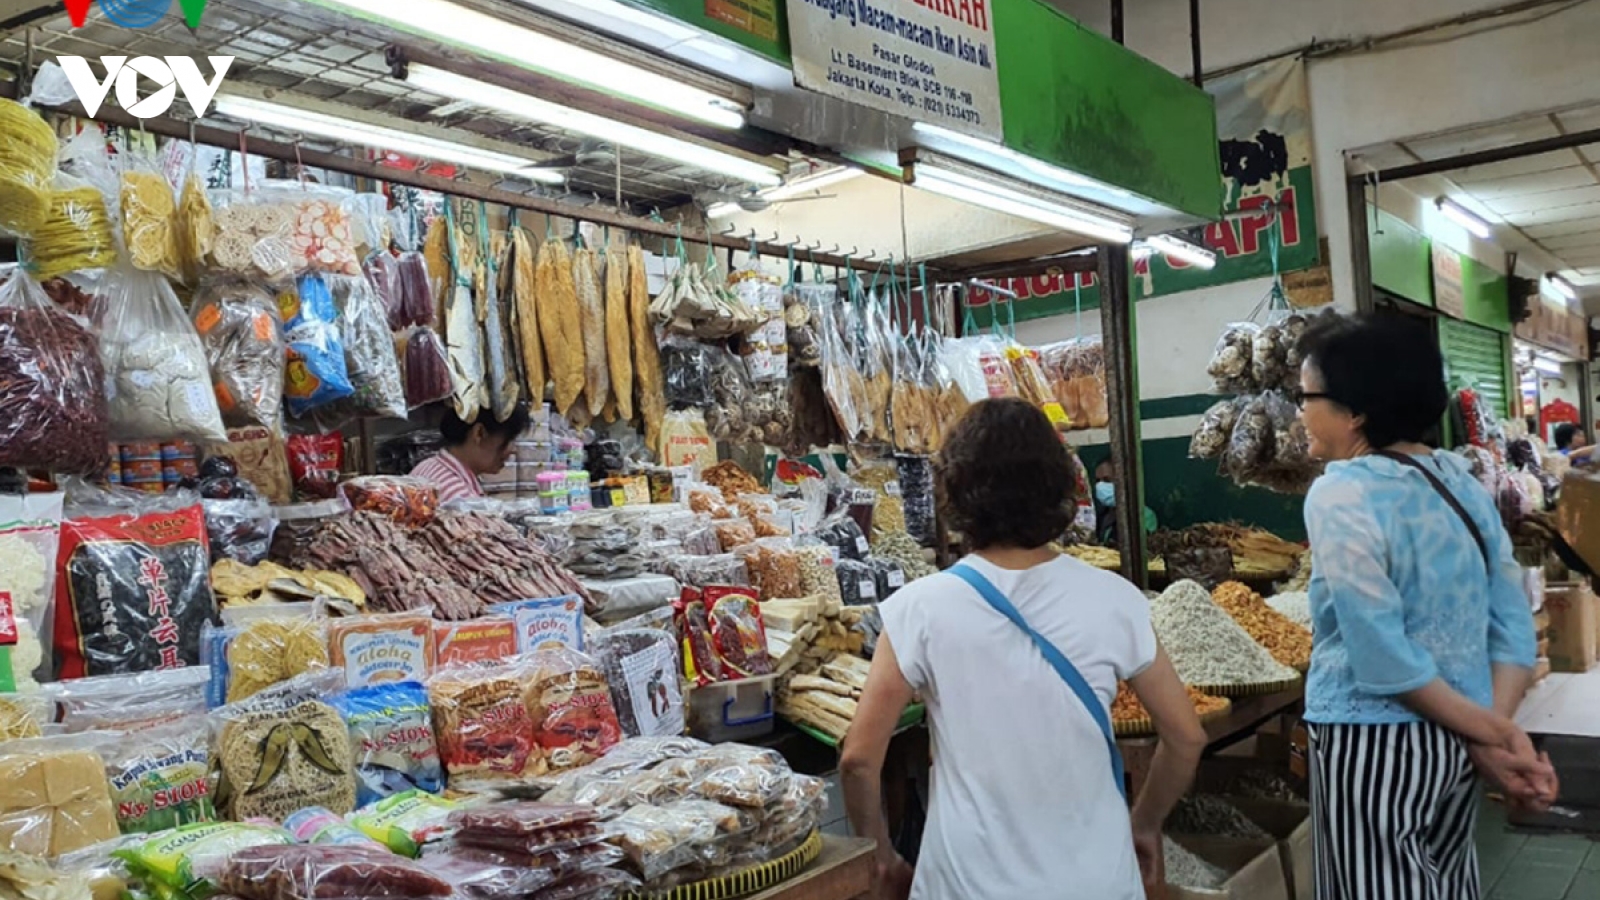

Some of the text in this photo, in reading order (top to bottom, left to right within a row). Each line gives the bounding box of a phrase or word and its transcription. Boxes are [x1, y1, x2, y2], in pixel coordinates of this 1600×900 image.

[872, 42, 936, 76] Pasar Glodok
[957, 34, 977, 64] Asin
[826, 66, 865, 91] Jakarta
[867, 78, 894, 100] Kota,
[895, 87, 917, 108] Telp.
[831, 48, 844, 65] Lt.
[847, 53, 897, 81] Basement
[899, 71, 920, 90] Blok
[1164, 184, 1300, 271] API
[357, 645, 412, 667] aloha
[387, 725, 430, 746] SIOK
[118, 800, 149, 819] Ny.
[153, 775, 209, 811] SIOK
